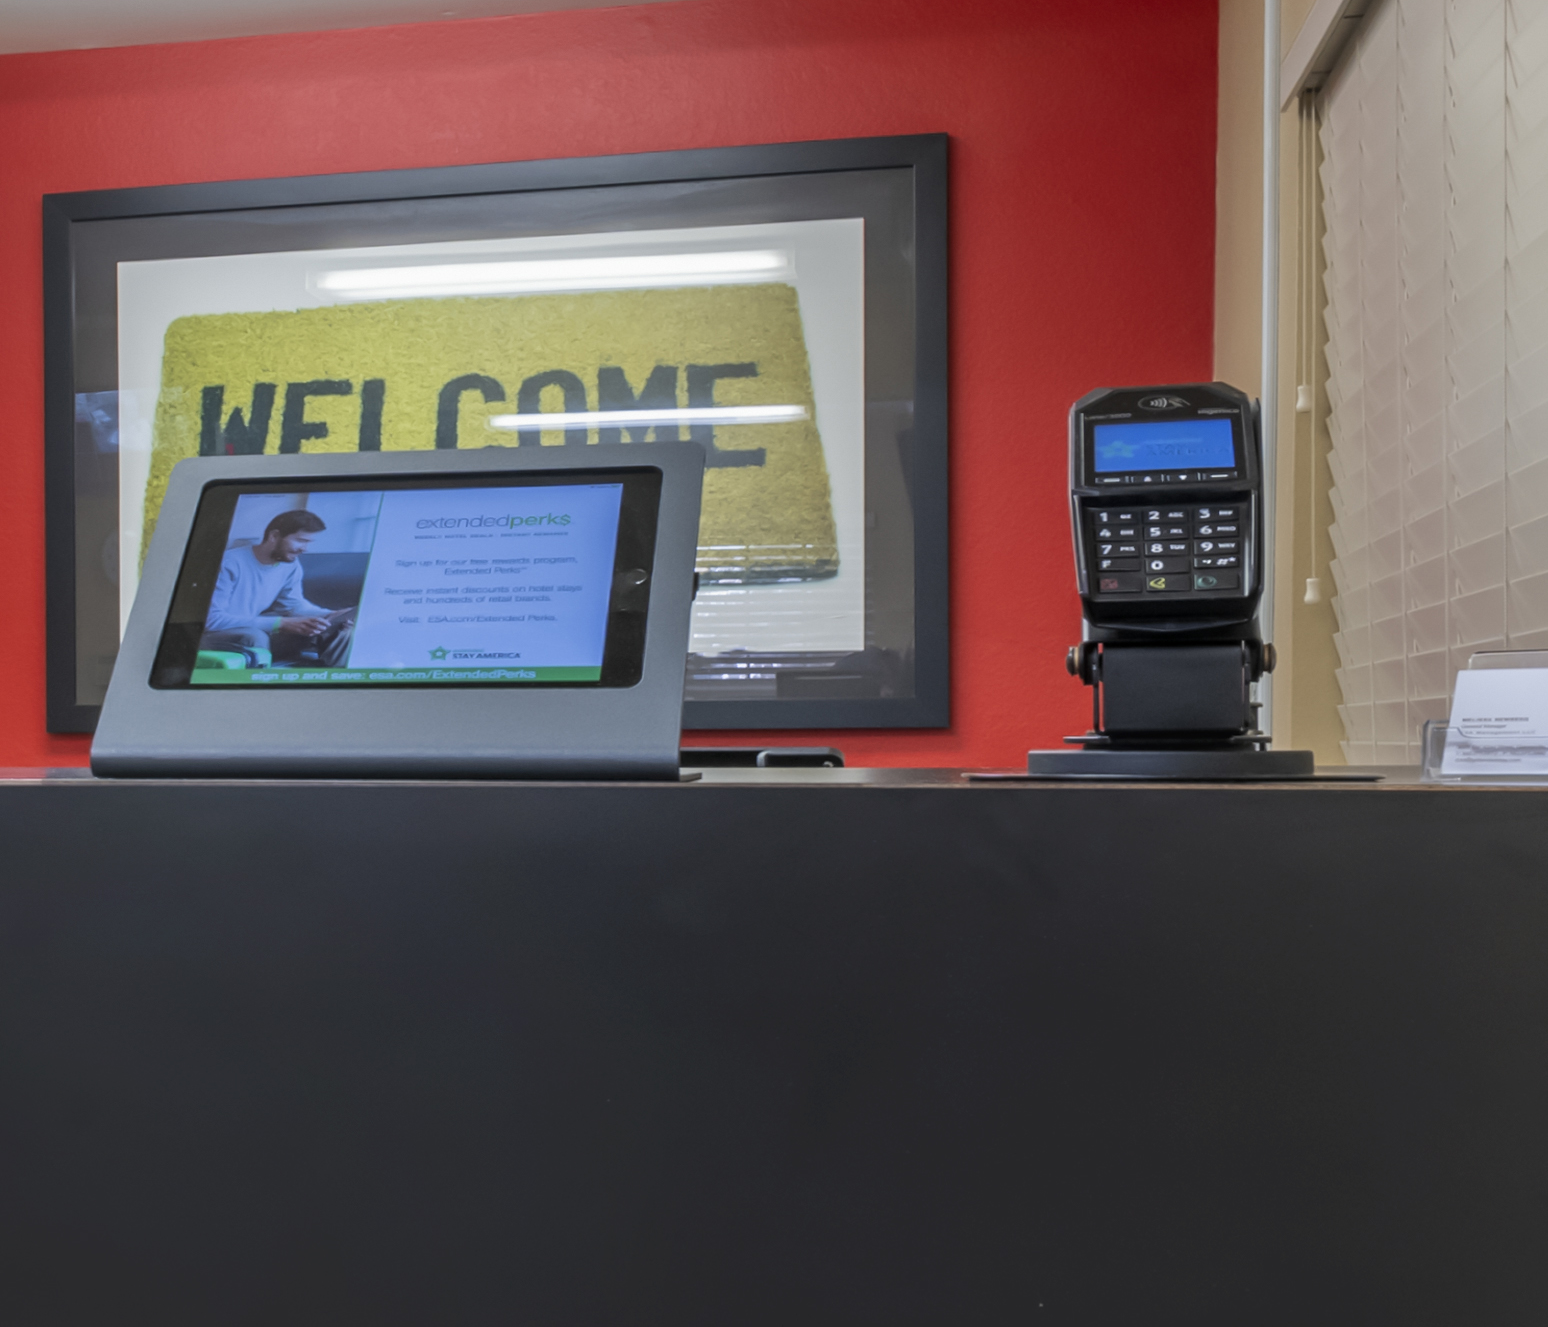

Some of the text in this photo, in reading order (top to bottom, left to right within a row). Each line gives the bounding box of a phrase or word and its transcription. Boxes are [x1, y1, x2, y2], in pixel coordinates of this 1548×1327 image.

[1099, 512, 1108, 522] 1
[1148, 510, 1160, 520] 2
[1149, 527, 1161, 537] 5
[1199, 525, 1213, 535] 6
[1101, 544, 1112, 554] 7
[1150, 543, 1163, 553] 8
[1200, 541, 1214, 552] 9
[419, 560, 433, 568] up
[435, 558, 448, 566] for
[444, 567, 492, 575] Extended
[384, 587, 423, 595] Receive
[426, 586, 458, 594] instant
[461, 585, 510, 593] discounts
[528, 584, 554, 592] hotel
[556, 584, 583, 593] stays
[403, 596, 423, 604] and
[425, 595, 474, 604] hundreds
[476, 595, 486, 603] of
[488, 594, 512, 603] retail
[251, 671, 279, 682] sign
[281, 672, 299, 682] up
[303, 671, 327, 680] and
